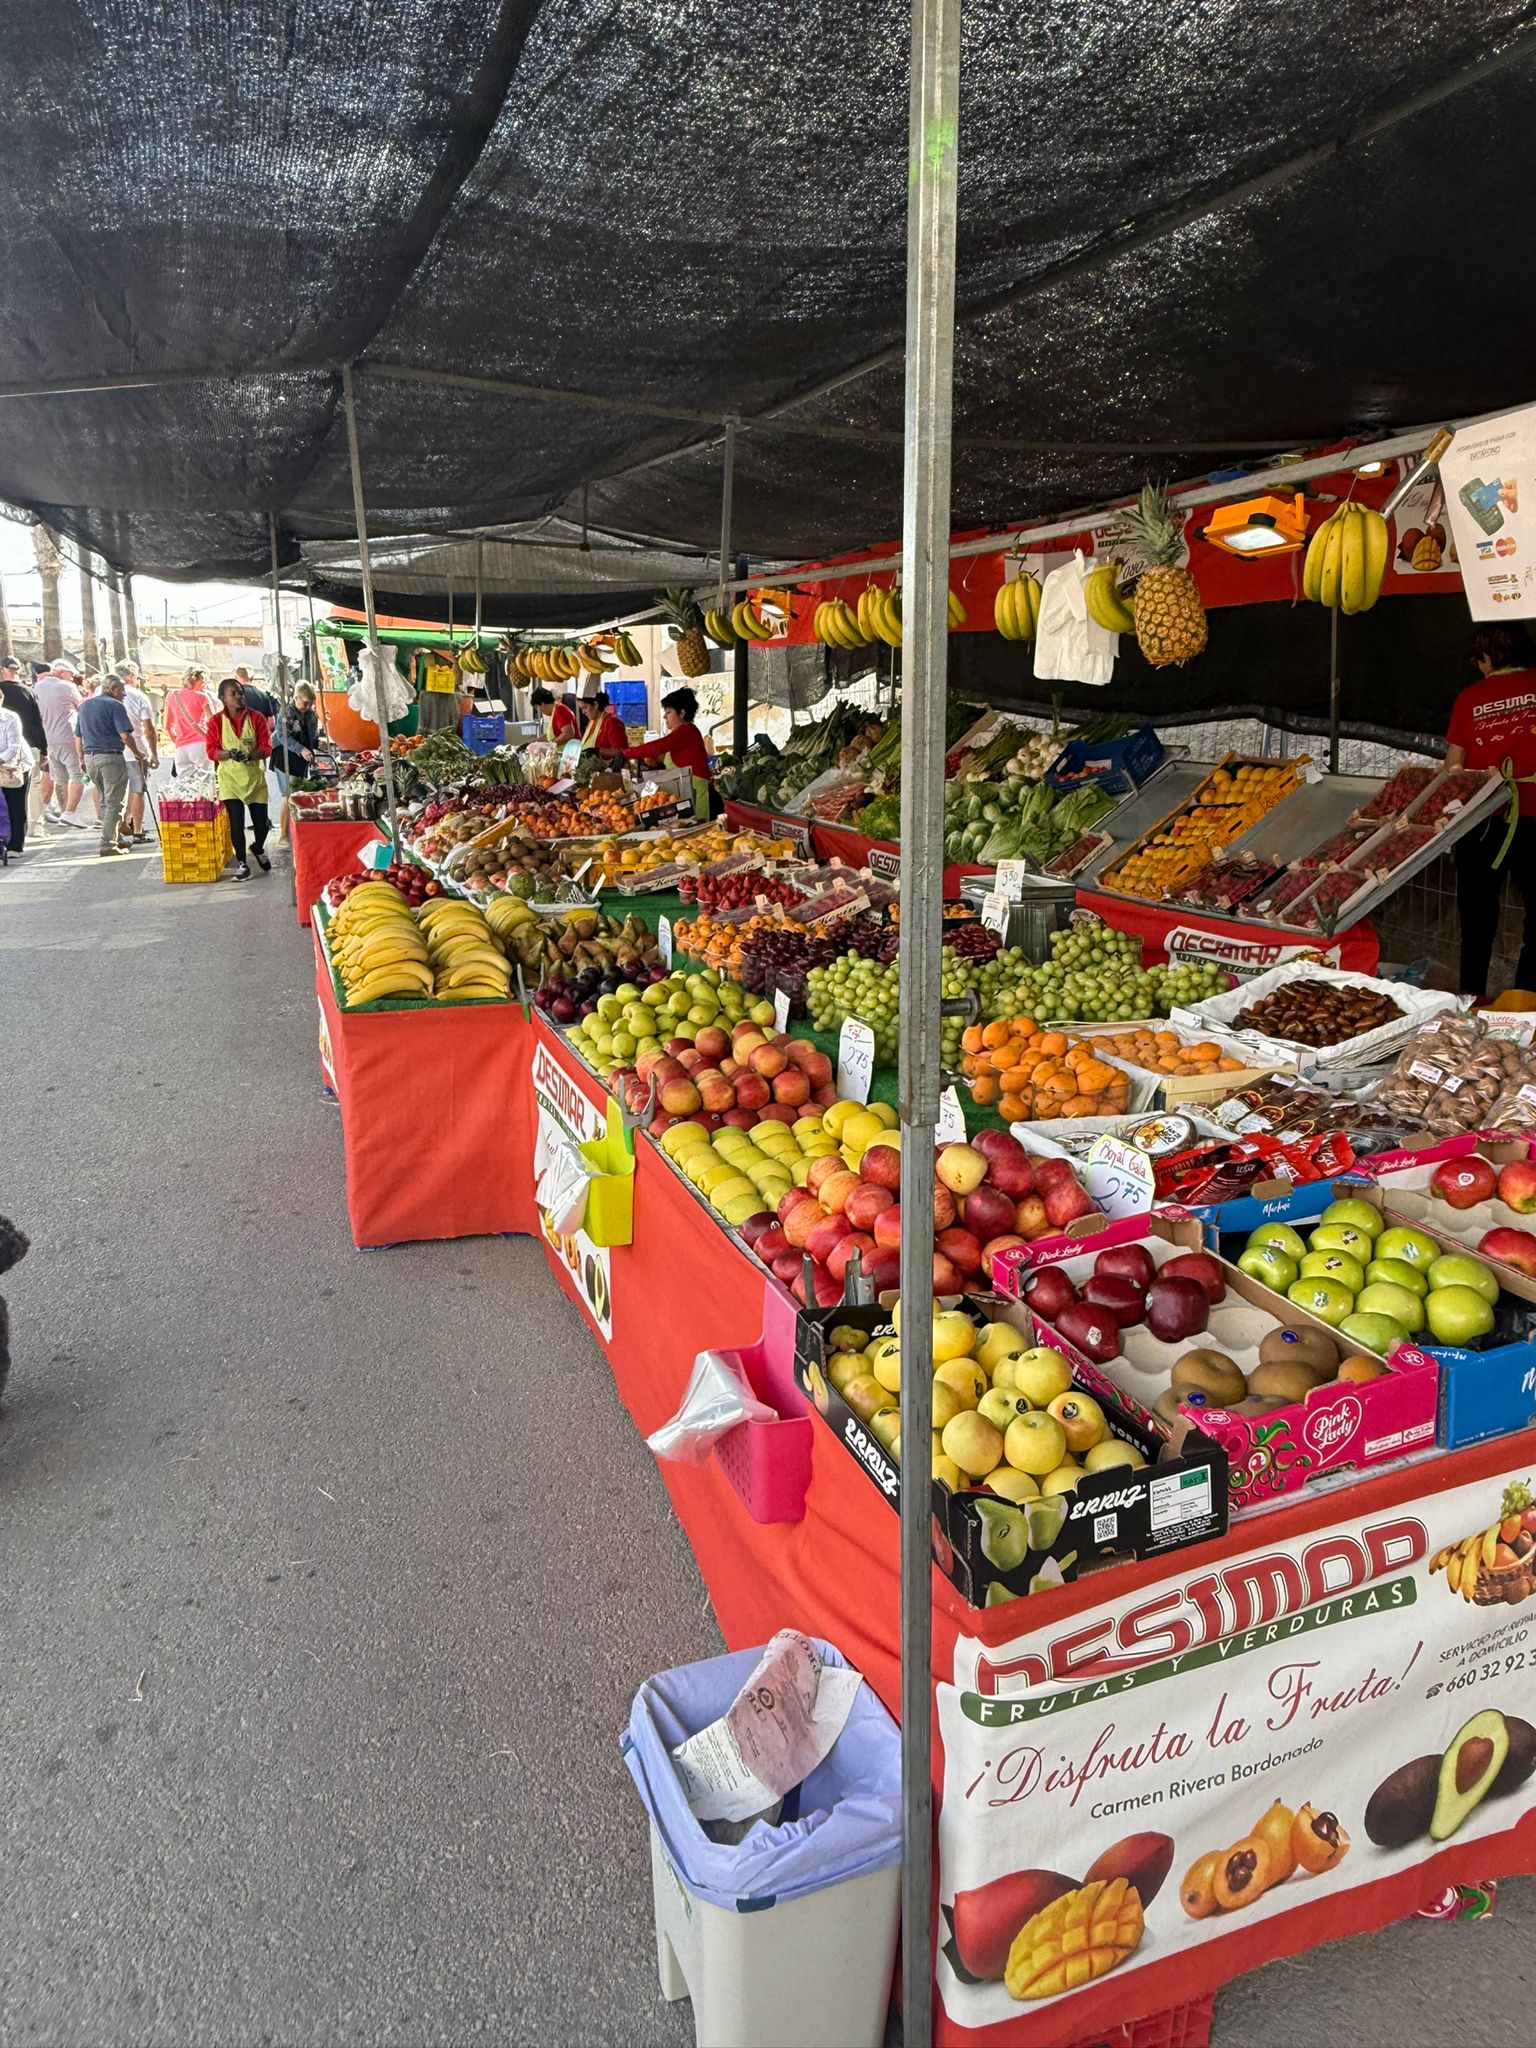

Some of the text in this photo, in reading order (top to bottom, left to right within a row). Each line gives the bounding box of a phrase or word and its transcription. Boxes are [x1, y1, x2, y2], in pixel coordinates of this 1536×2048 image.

[536, 1046, 587, 1140] DESIMAR
[1313, 1402, 1351, 1439] Pink
[1318, 1419, 1353, 1449] Lady
[1069, 1484, 1147, 1520] ERRUZ
[980, 1583, 1404, 1722] FRUTAS Y VERDURAS
[1446, 1669, 1477, 1693] 660
[1480, 1660, 1501, 1681] 32
[1505, 1652, 1525, 1674] 92
[1206, 1692, 1252, 1748] la
[1266, 1640, 1424, 1731] Fruta!
[1090, 1737, 1324, 1819] Carmen Rivera Bordonado
